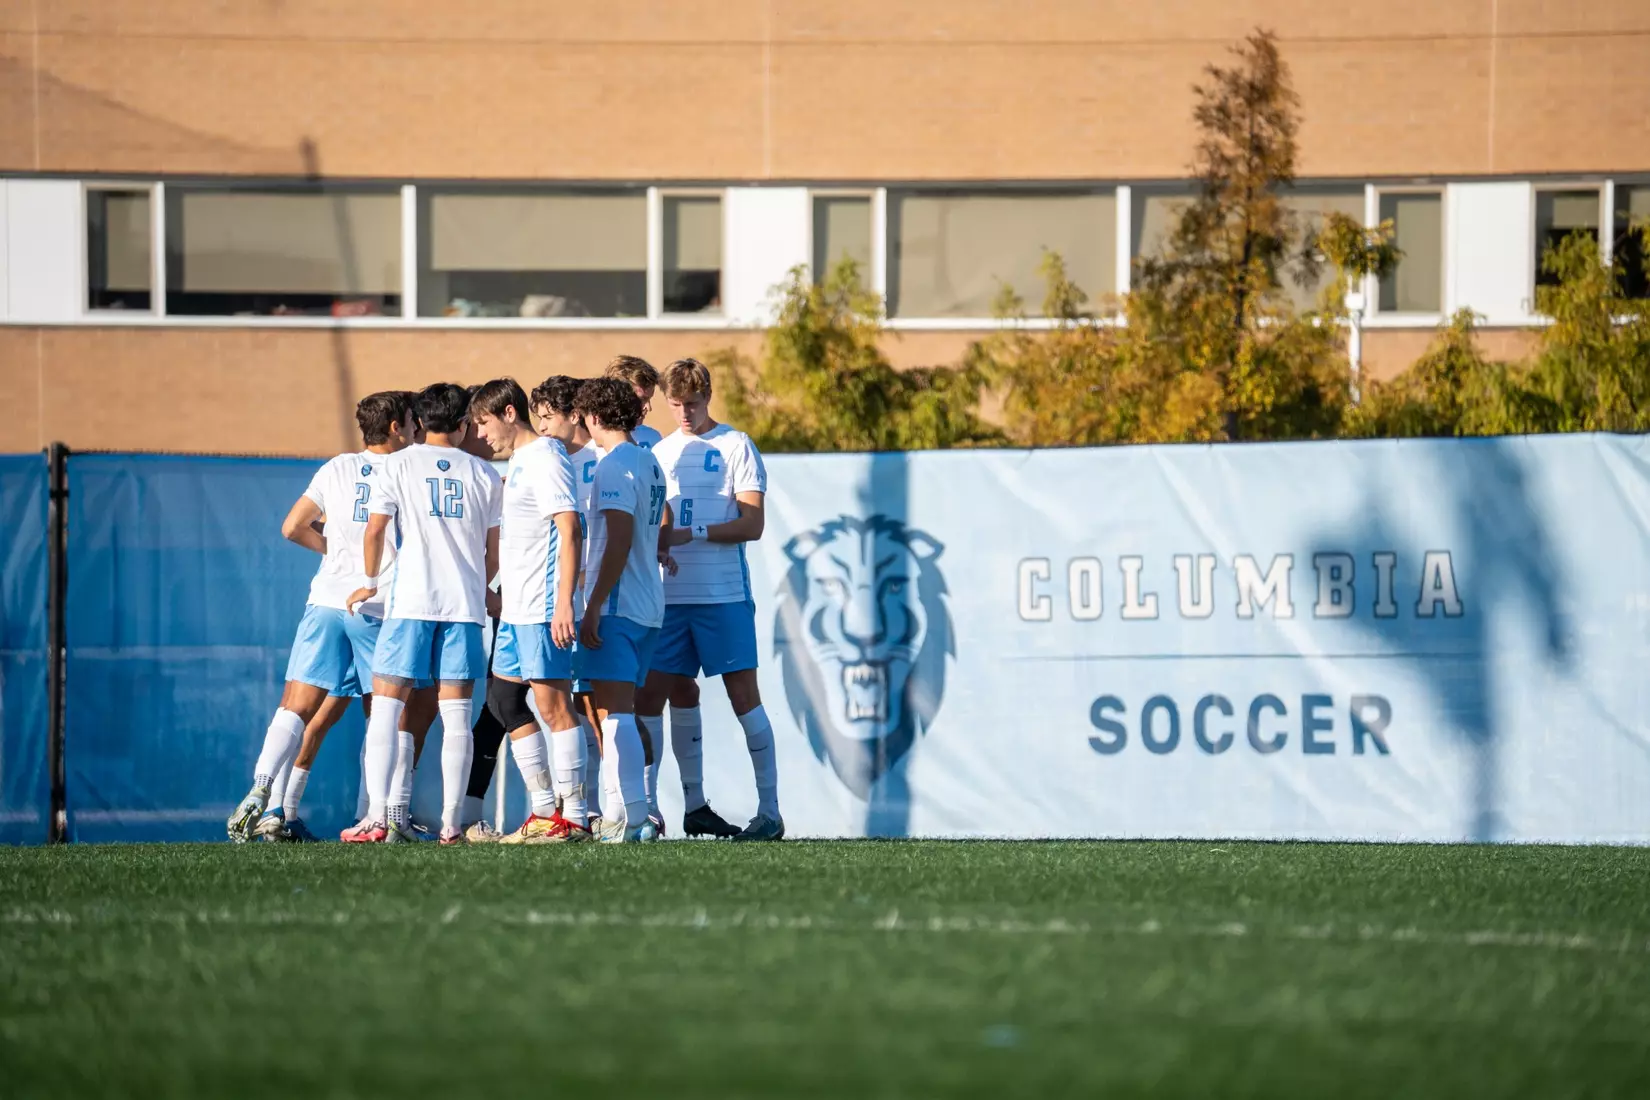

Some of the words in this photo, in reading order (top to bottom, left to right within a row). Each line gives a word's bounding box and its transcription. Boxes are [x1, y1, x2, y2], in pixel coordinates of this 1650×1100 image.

[703, 450, 721, 473] C
[352, 482, 371, 522] 2
[426, 477, 464, 518] 12
[648, 485, 667, 525] 27
[680, 498, 694, 527] 6
[1017, 549, 1464, 622] COLUMBIA
[1088, 693, 1393, 756] SOCCER
